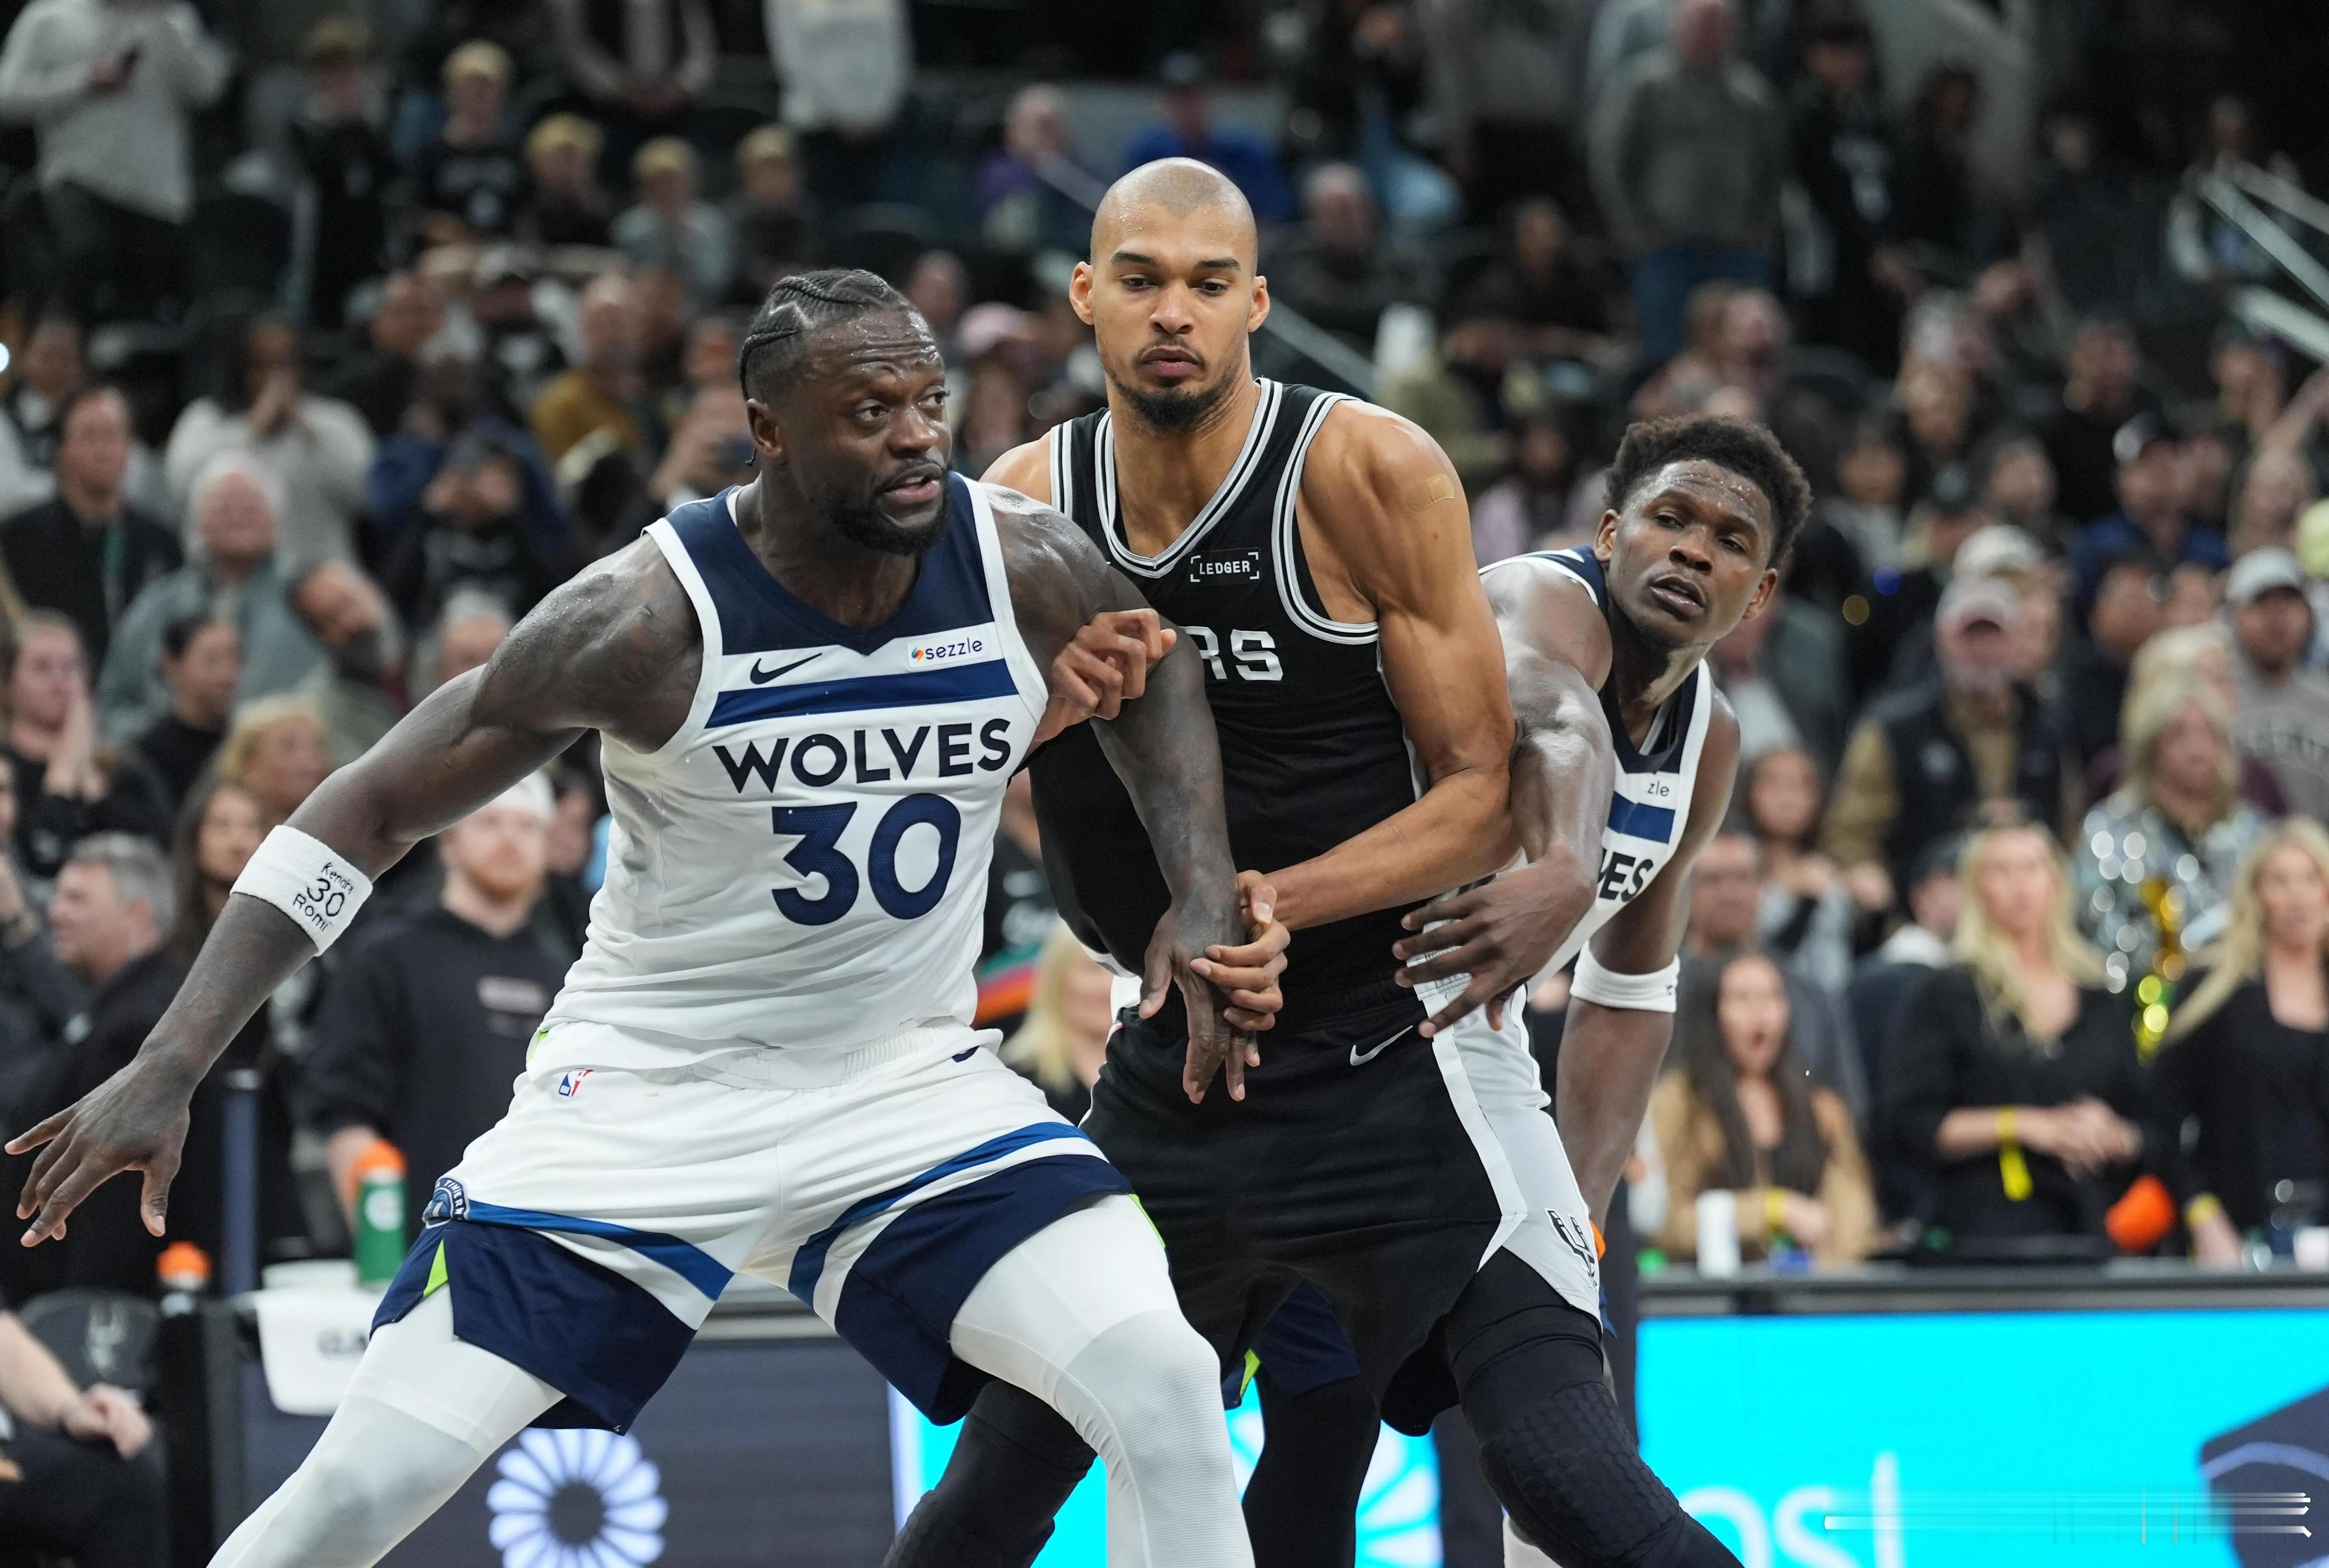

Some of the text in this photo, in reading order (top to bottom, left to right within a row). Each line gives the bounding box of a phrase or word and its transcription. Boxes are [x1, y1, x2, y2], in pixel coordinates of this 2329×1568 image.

[1199, 560, 1250, 575] LEDGER
[925, 637, 982, 660] sezzle
[711, 718, 1011, 794] WOLVES
[771, 793, 961, 926] 30
[1597, 848, 1654, 902] ES
[293, 893, 333, 932] Romi
[307, 878, 345, 916] 30
